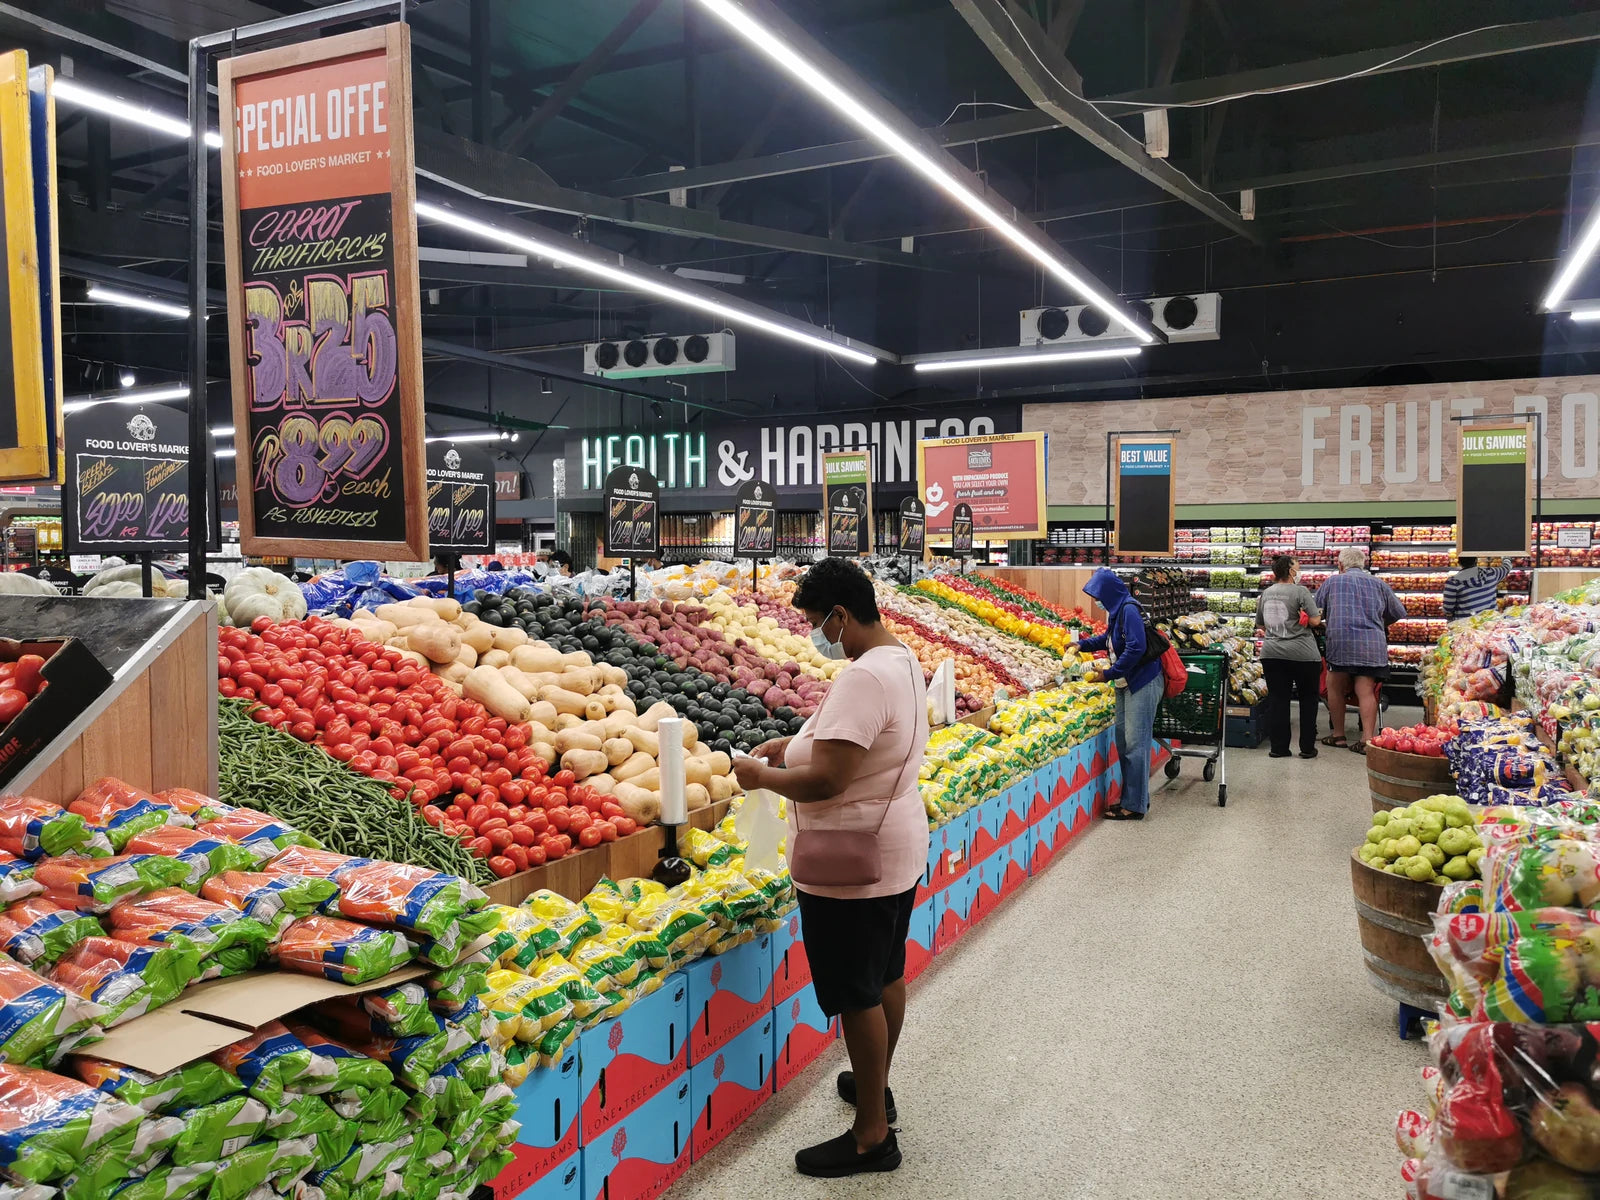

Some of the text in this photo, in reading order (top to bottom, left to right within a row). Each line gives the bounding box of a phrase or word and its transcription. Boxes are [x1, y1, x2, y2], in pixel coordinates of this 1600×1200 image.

[256, 151, 371, 177] FOOD LOVER'S MARKET
[250, 200, 362, 247] CARROT
[85, 438, 189, 455] FOOD LOVER'S MARKE
[961, 435, 988, 444] LOVER'S
[989, 434, 1015, 442] MARKET
[582, 432, 707, 490] HEALTH
[718, 439, 755, 487] &
[1121, 449, 1168, 463] BEST VALUE
[342, 467, 392, 500] each
[437, 470, 461, 479] LOVER'S
[461, 472, 485, 480] MARKET
[262, 506, 288, 523] AS
[0, 1018, 22, 1041] since
[9, 1021, 41, 1049] FRESH
[695, 1037, 719, 1059] LONE
[723, 1024, 741, 1039] TREE
[587, 1062, 684, 1136] LONE TREE FARMS
[696, 1131, 720, 1154] LONE
[725, 1110, 743, 1129] TREE
[534, 1140, 574, 1175] FARMS
[658, 1156, 690, 1188] FARMS
